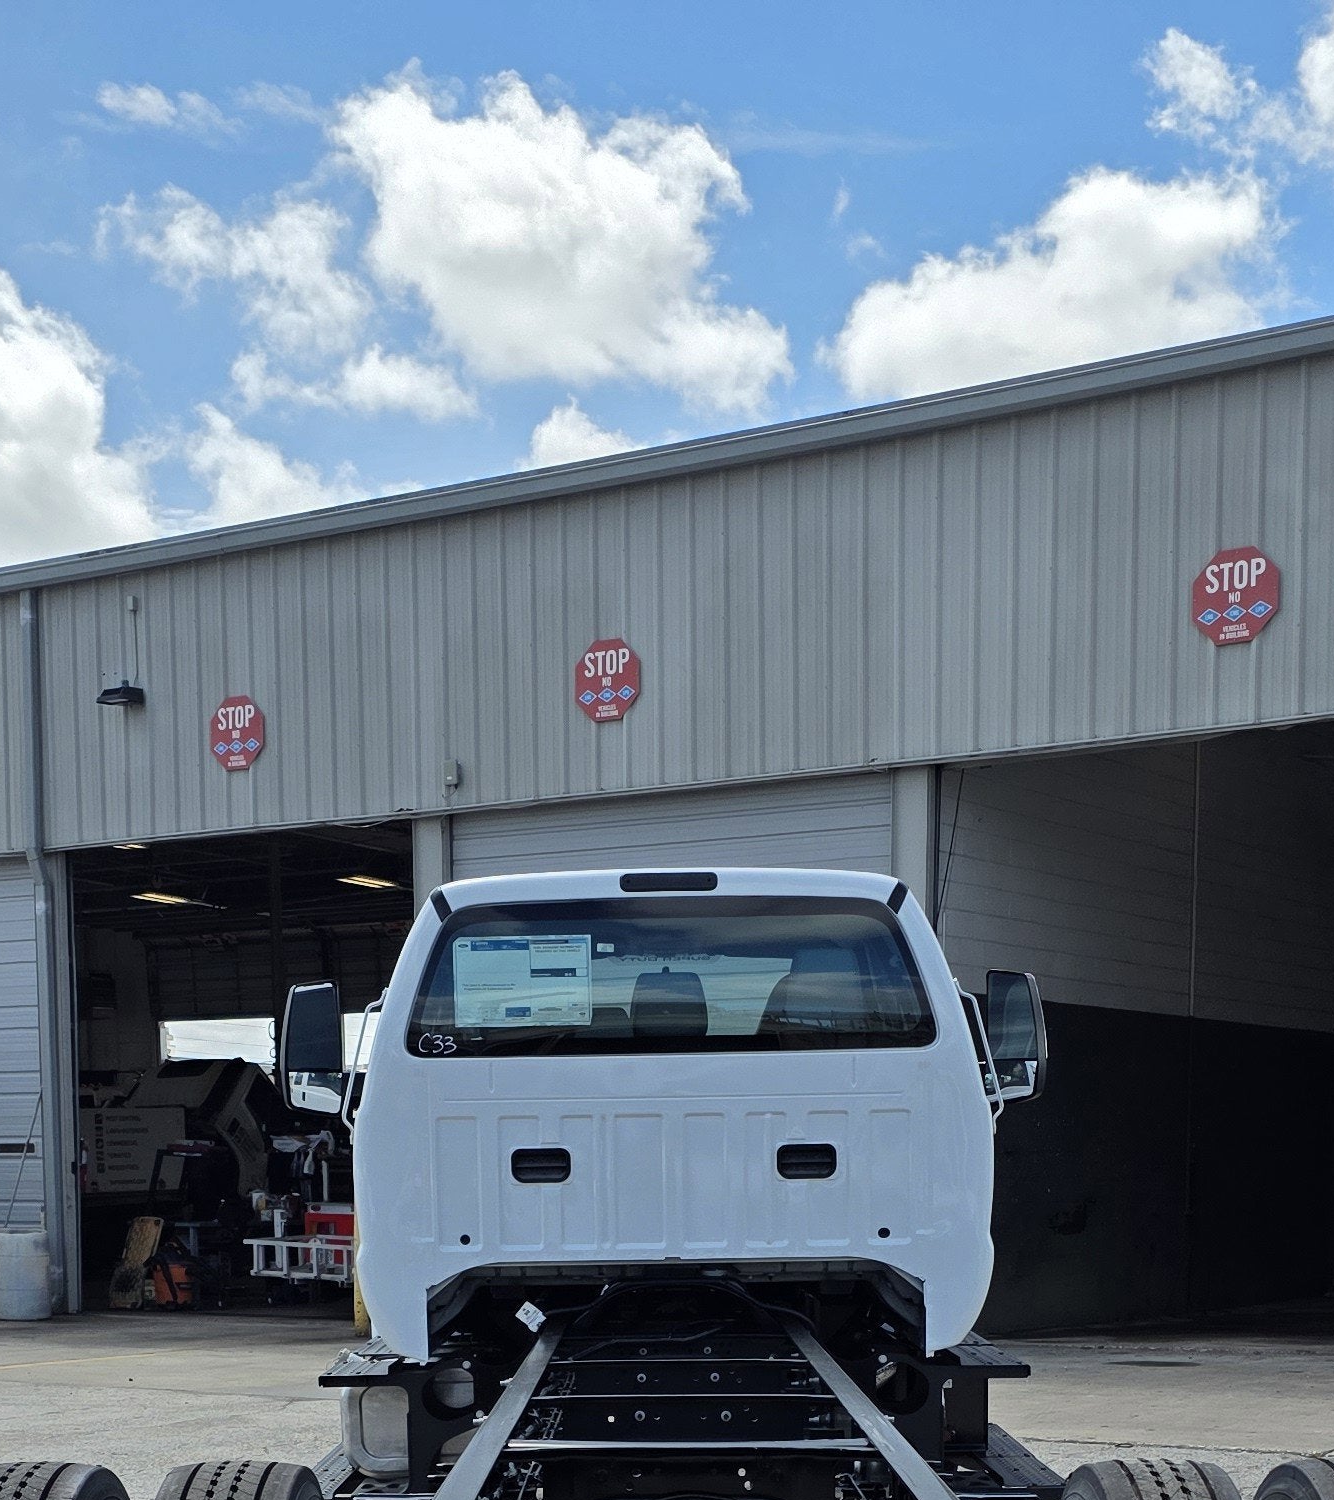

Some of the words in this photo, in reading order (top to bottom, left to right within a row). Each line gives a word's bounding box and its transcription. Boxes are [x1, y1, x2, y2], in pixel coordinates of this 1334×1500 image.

[1205, 557, 1266, 594] STOP
[1228, 591, 1241, 604] NO
[584, 648, 630, 678] STOP
[601, 676, 612, 688] NO
[217, 704, 255, 731] STOP
[419, 1033, 457, 1054] C33
